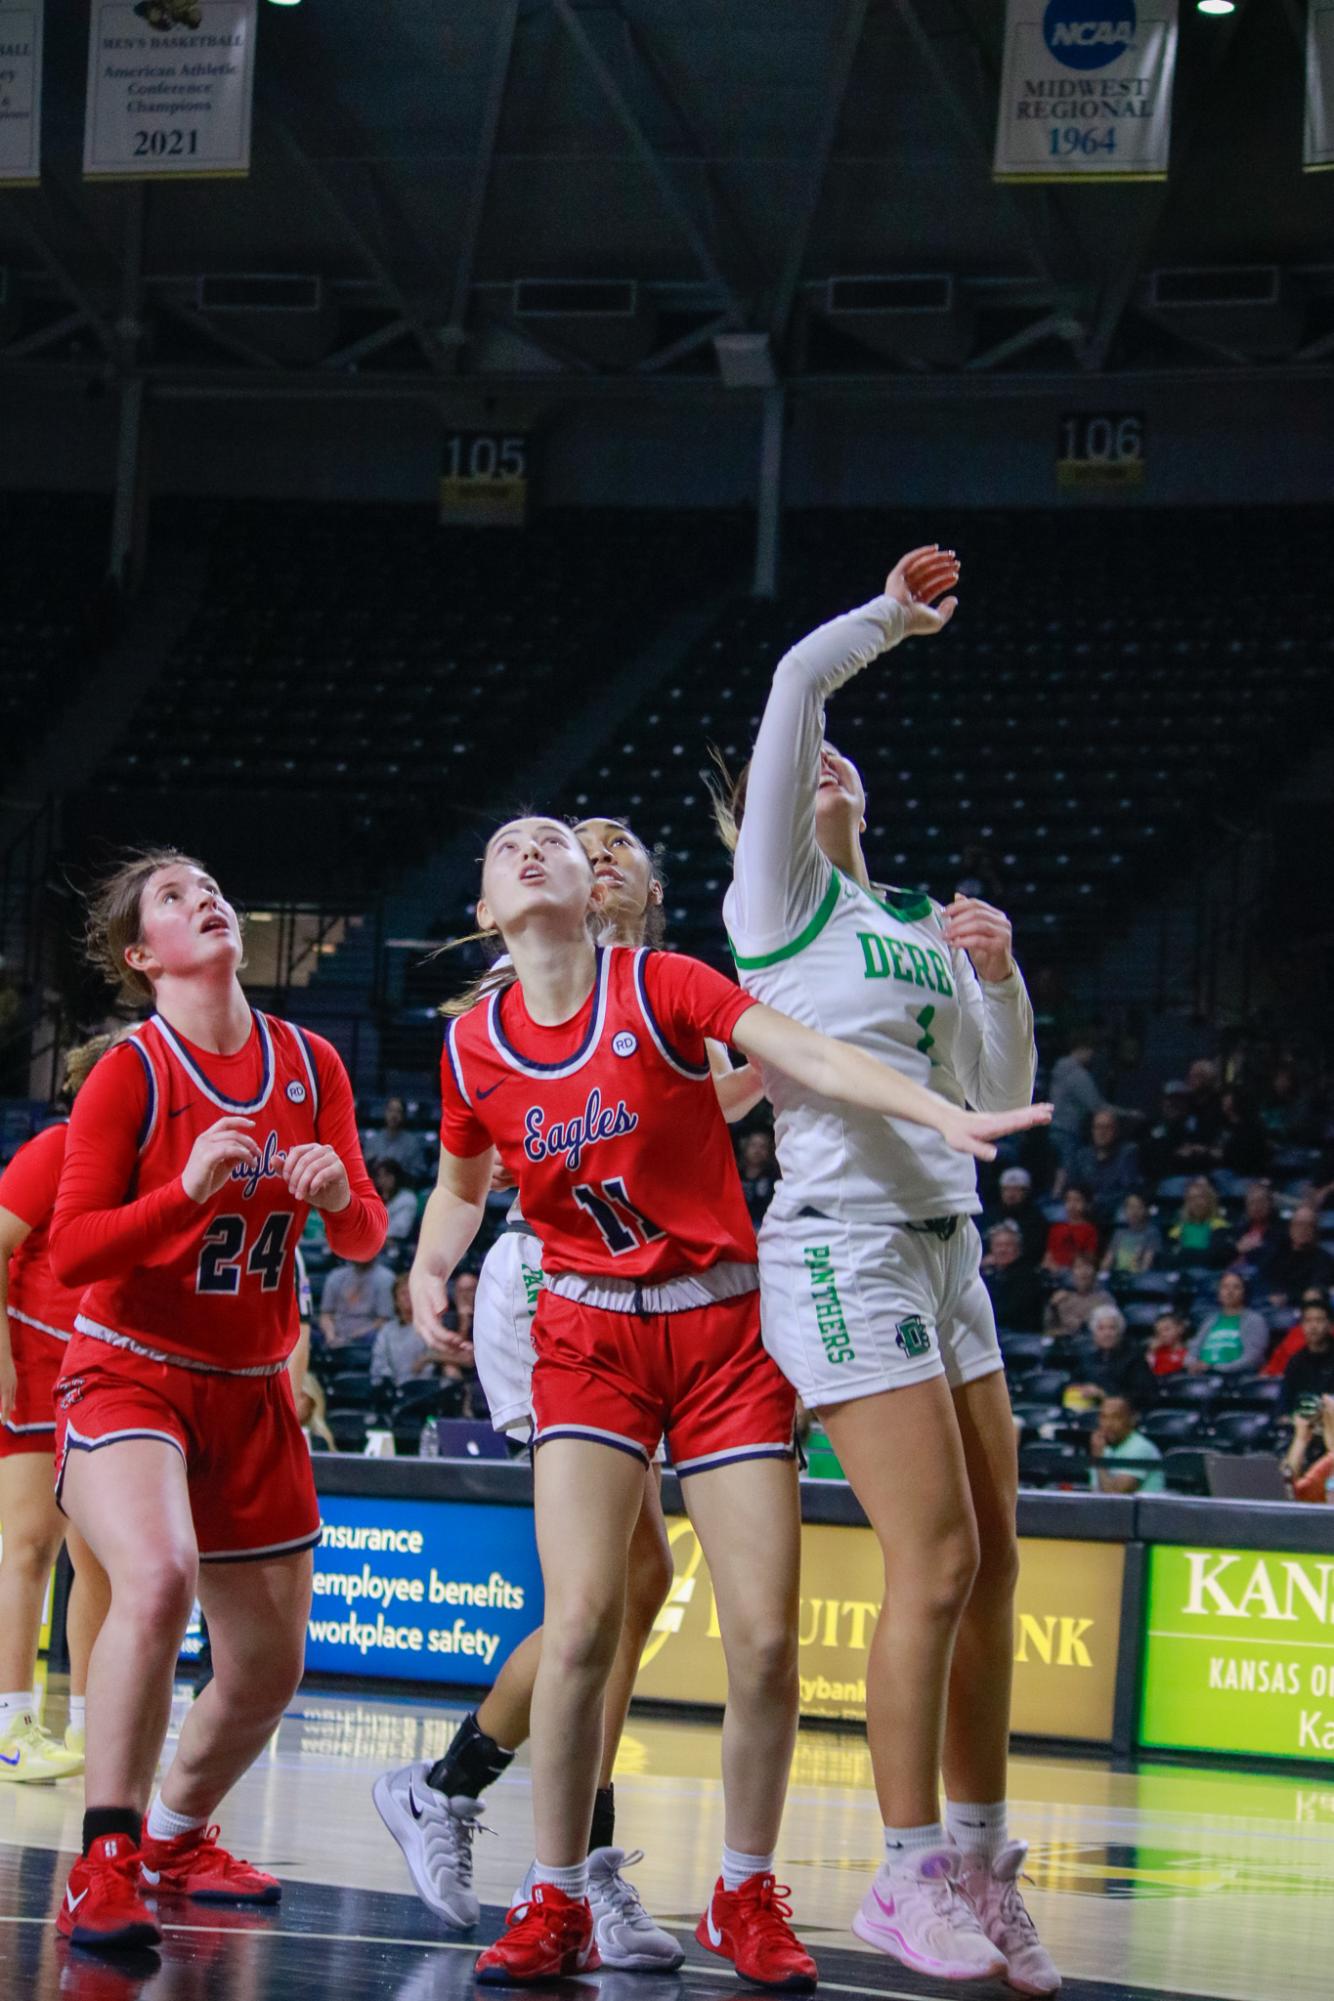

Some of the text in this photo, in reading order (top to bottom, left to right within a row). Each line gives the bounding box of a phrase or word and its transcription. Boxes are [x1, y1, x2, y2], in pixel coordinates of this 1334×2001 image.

[151, 35, 243, 49] BASKETBALL
[1051, 22, 1134, 46] NCAA
[105, 63, 236, 78] American Athletic
[128, 82, 213, 96] Conference
[1024, 78, 1149, 99] MIDWEST
[127, 101, 212, 116] Champions
[1016, 99, 1152, 120] REGIONAL
[133, 129, 199, 157] 2021
[1050, 127, 1117, 155] 1964
[1063, 417, 1141, 463] 106
[448, 437, 525, 481] 105
[524, 1087, 639, 1171] Eagles
[572, 1176, 667, 1257] 11
[195, 1211, 294, 1295] 24
[804, 1246, 855, 1364] PANTHERS
[312, 1563, 524, 1609] employee benefits
[308, 1611, 500, 1665] workplace safety
[1209, 1657, 1334, 1699] KANSAS O
